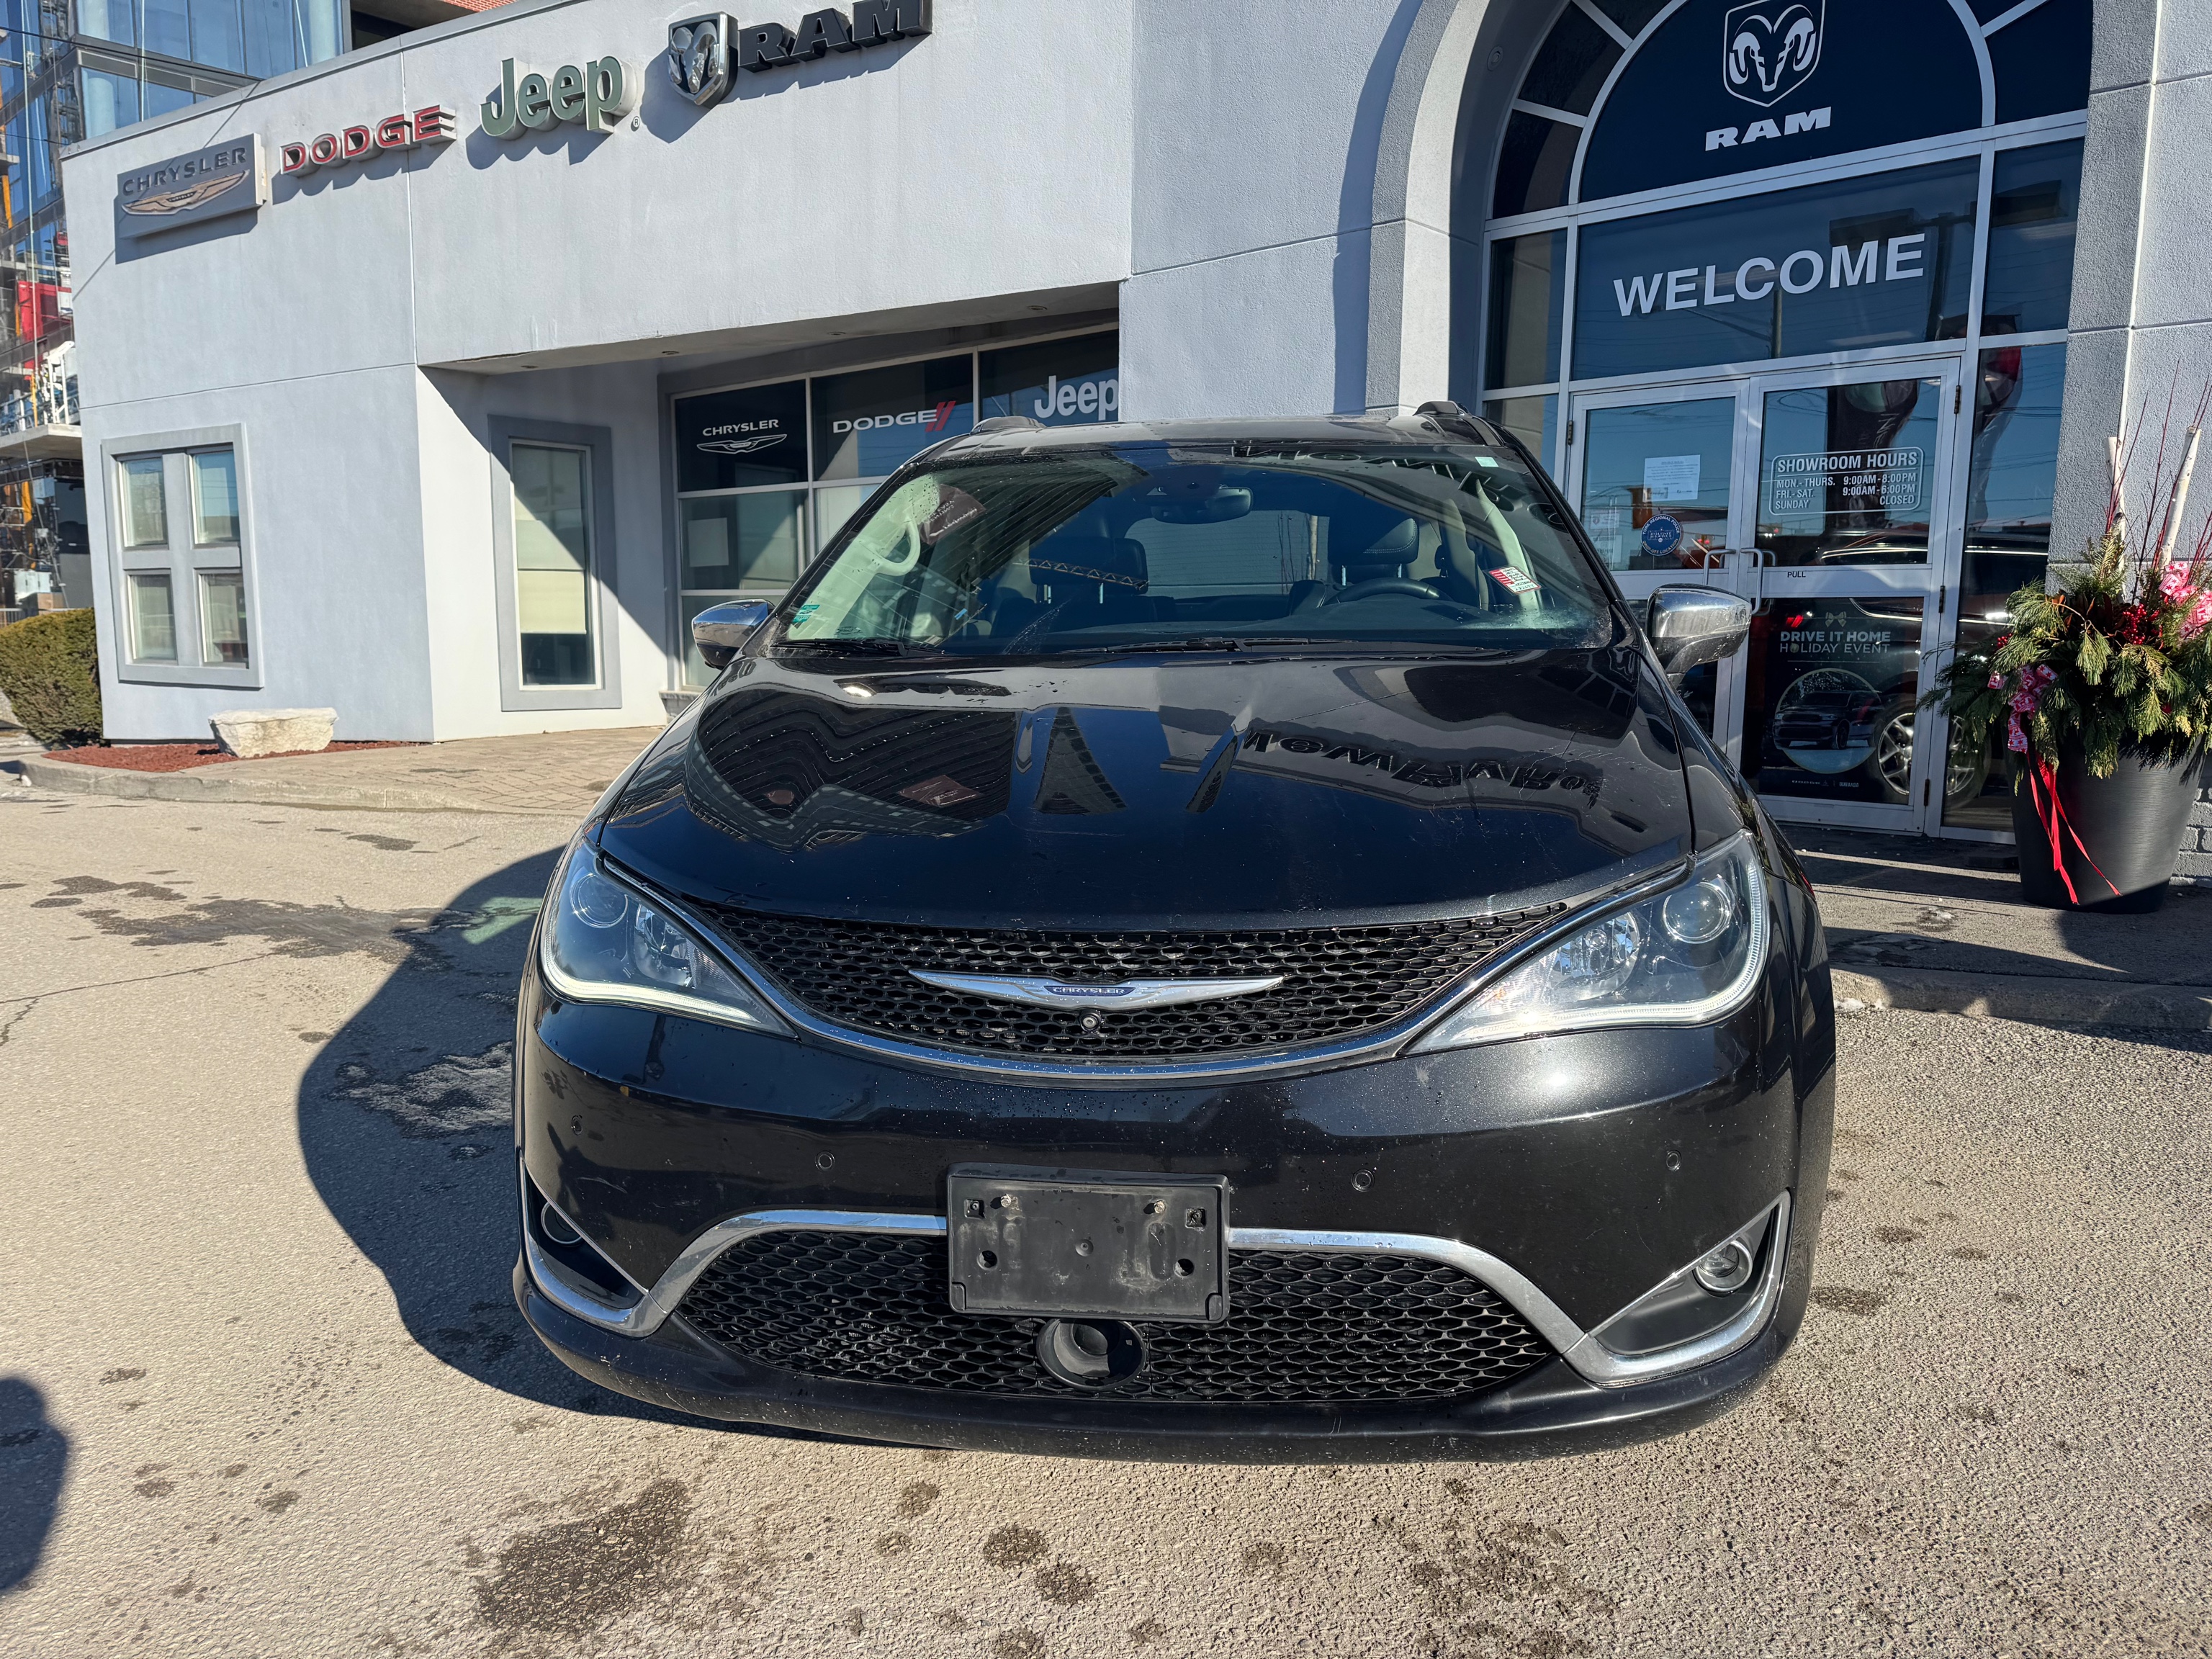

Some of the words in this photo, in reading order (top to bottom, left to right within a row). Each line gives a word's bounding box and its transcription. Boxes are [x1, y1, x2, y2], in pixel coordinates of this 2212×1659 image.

[737, 0, 921, 67] RAM
[480, 55, 626, 137] Jeep
[279, 104, 446, 175] DODGE
[1704, 107, 1832, 151] RAM
[122, 147, 247, 196] CHRYSLER
[1613, 233, 1925, 317] WELCOME
[1034, 375, 1118, 421] Jeep
[702, 419, 779, 436] CHRYSLER
[833, 409, 938, 433] DODGE
[1777, 455, 1861, 472] SHOWROOM
[1867, 451, 1917, 467] HOURS
[1797, 488, 1814, 498] SAT.
[1804, 477, 1835, 487] THURS.
[1775, 499, 1809, 510] SUNDAY
[1879, 495, 1915, 505] CLOSED
[1779, 643, 1838, 654] HOLIDAY
[1844, 643, 1891, 654] EVENT
[1781, 631, 1825, 642] DRIVE
[1830, 631, 1843, 642] IT
[1846, 631, 1891, 642] HOME
